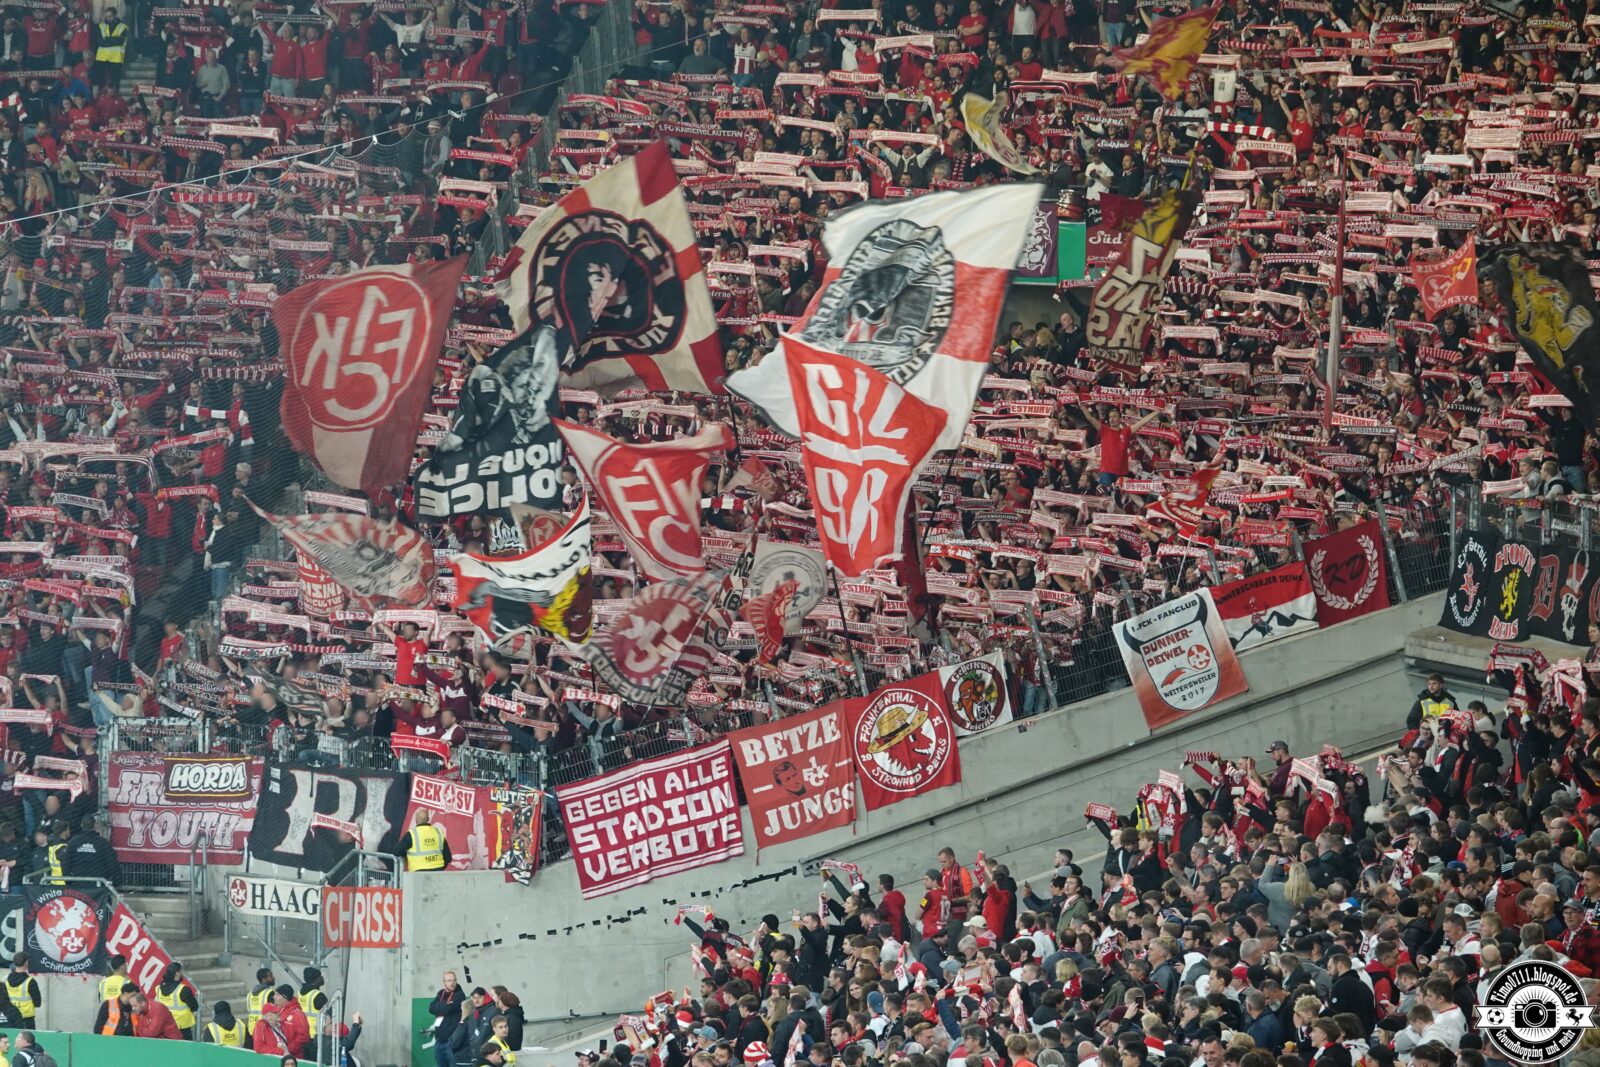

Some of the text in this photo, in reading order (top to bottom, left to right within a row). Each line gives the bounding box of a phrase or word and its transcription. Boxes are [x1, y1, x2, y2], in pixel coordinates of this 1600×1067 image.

[1471, 173, 1522, 182] WESTKURVE
[1332, 415, 1376, 427] WESTKURVE
[1157, 599, 1198, 625] FANCLUB
[1141, 628, 1194, 656] DUNNER-
[1146, 645, 1186, 668] DEIWEL
[1163, 672, 1217, 699] WEITERSWEILER
[1181, 686, 1206, 702] 2017
[860, 691, 915, 743] FRANKENTHAL
[739, 711, 842, 768] BETZE
[926, 737, 947, 776] DEVILS
[169, 762, 247, 792] HORDA
[565, 756, 729, 824] GEGEN ALLE
[415, 780, 473, 815] SEK SV
[763, 781, 856, 838] JUNGS
[127, 809, 242, 848] YOUTH
[571, 781, 735, 854] STADION
[582, 812, 742, 882] VERBOTE
[37, 888, 63, 904] White
[250, 885, 320, 916] HAAG
[325, 891, 400, 944] CHRISSI
[40, 956, 94, 974] Schifferstadt
